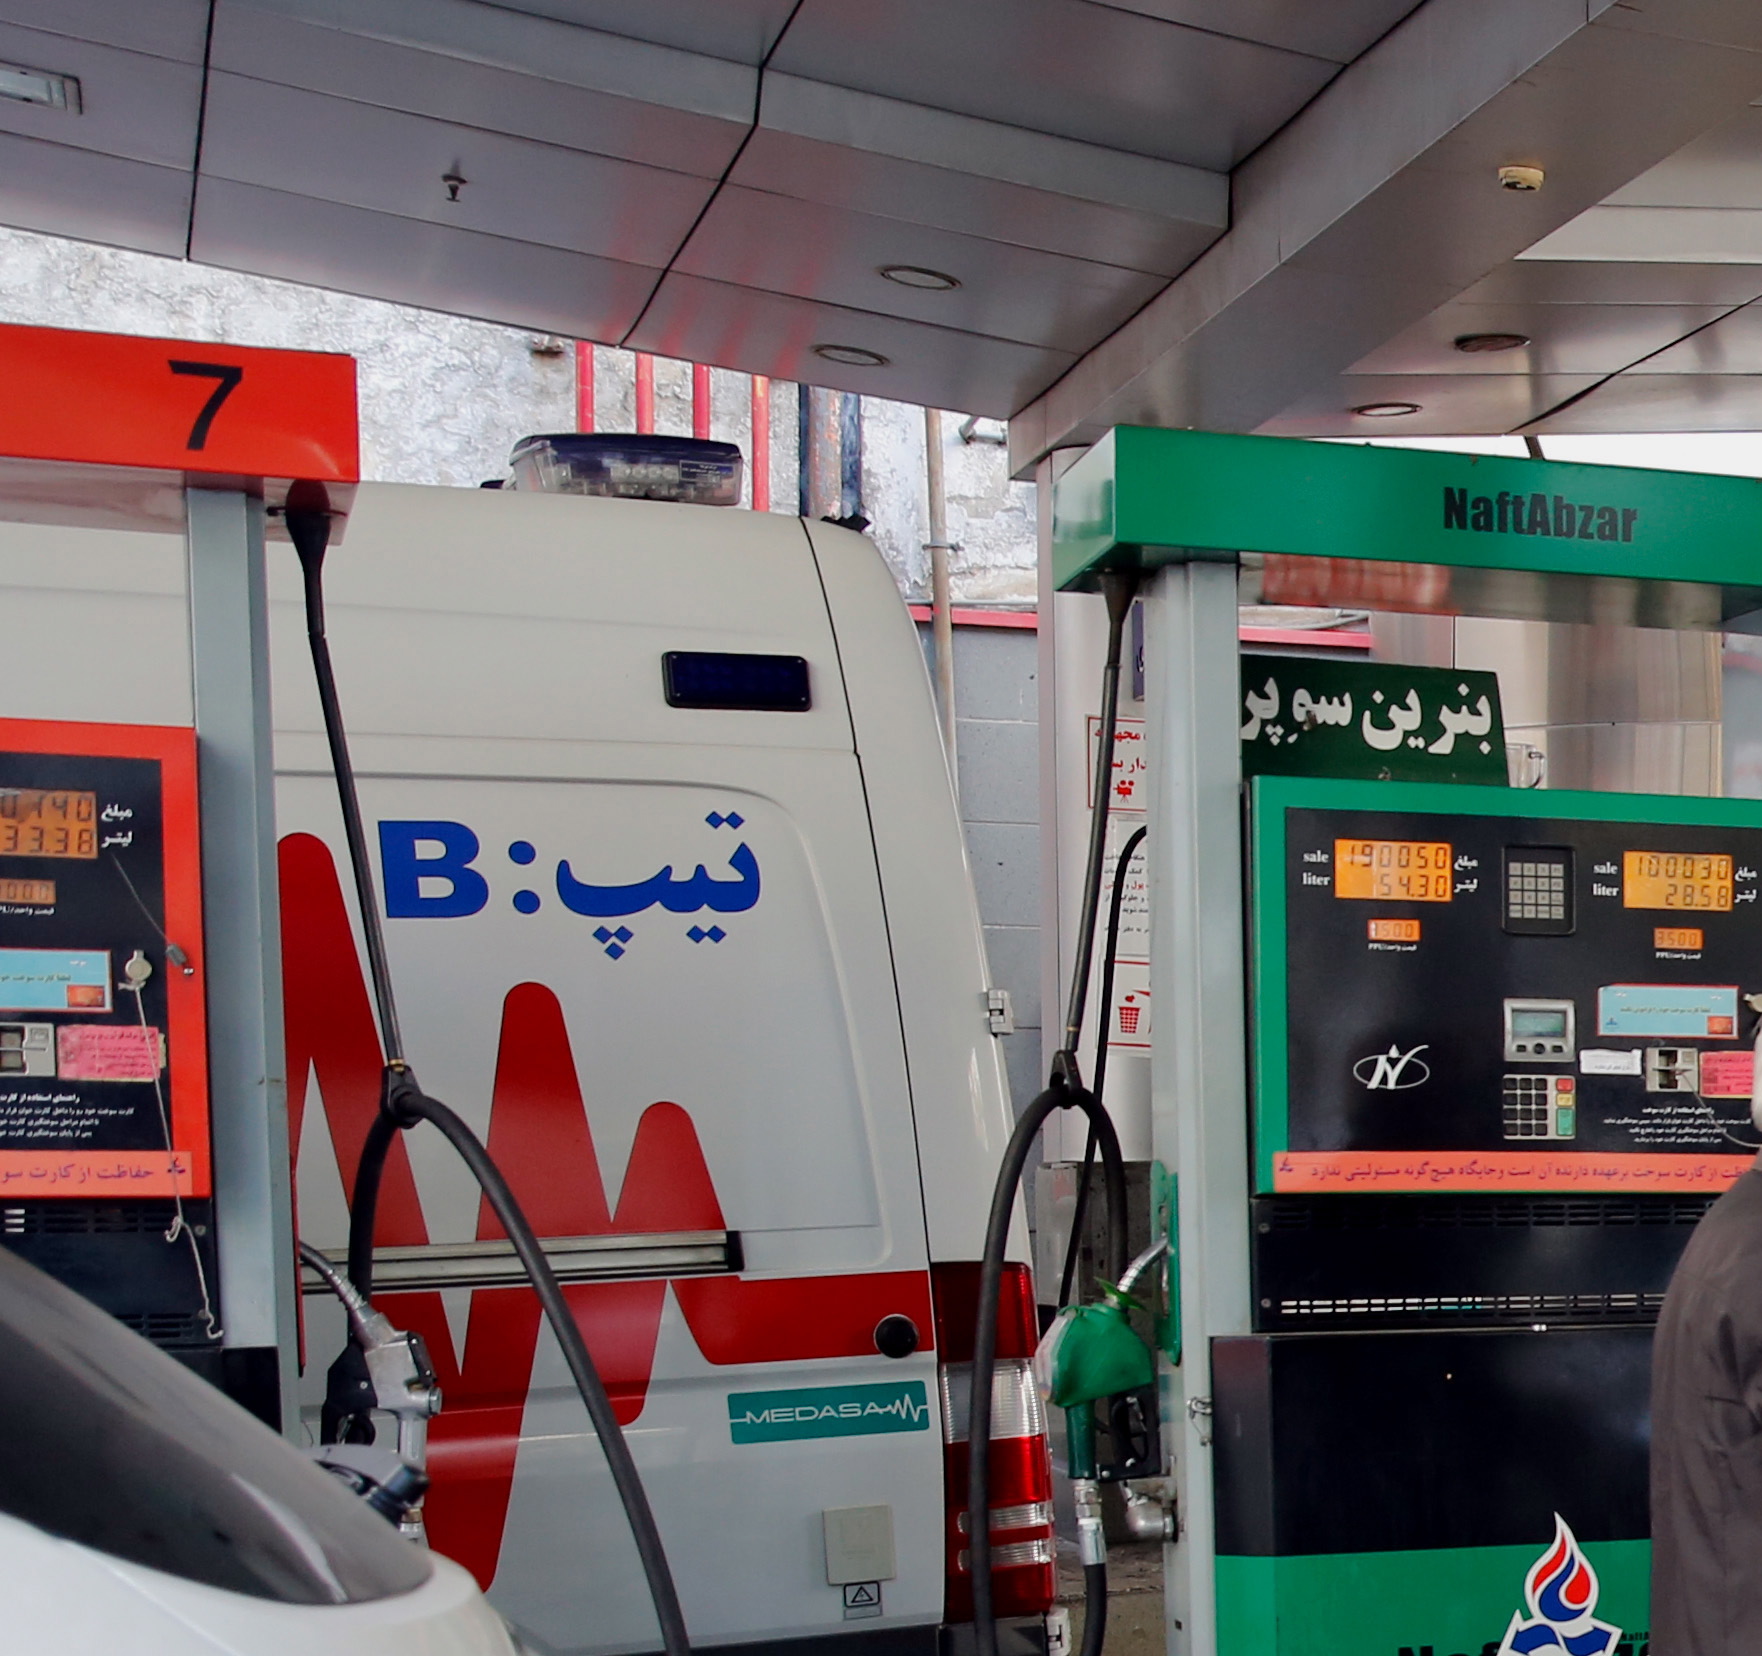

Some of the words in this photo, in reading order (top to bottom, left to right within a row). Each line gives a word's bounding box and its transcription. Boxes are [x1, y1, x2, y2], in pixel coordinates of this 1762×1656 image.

[167, 360, 243, 452] 7
[1442, 486, 1639, 544] NaftAbzar
[100, 803, 134, 822] مبلغ
[101, 830, 133, 848] لیتر
[1302, 850, 1330, 864] sale
[1453, 854, 1479, 871] مبلغ
[1593, 861, 1618, 875] sale
[1734, 866, 1758, 882] مبلغ
[1302, 871, 1331, 886] liter
[1453, 878, 1479, 893] لیتر
[1592, 883, 1620, 897] liter
[1733, 888, 1757, 903] لیتر
[29, 1162, 76, 1184] کارت
[78, 1166, 92, 1184] از
[95, 1163, 155, 1180] حفاظت
[745, 1401, 881, 1424] MEDASA
